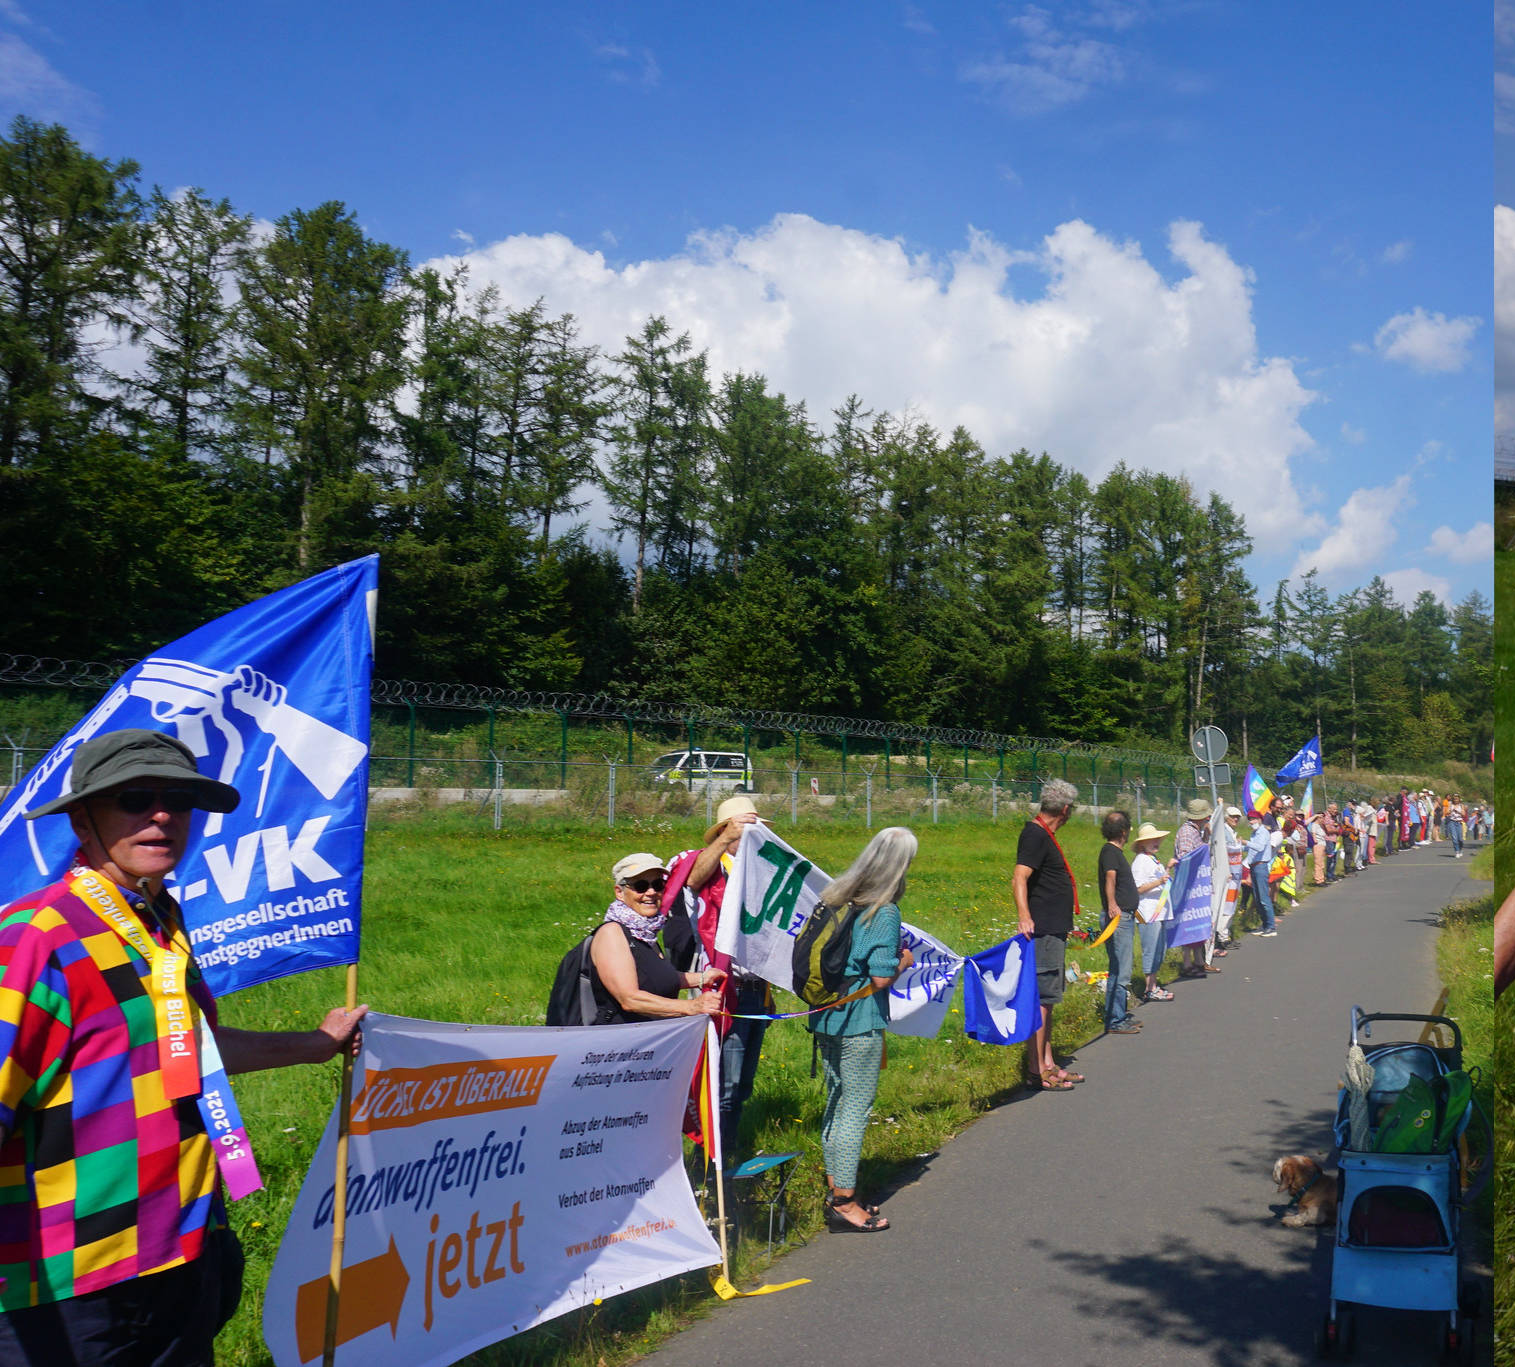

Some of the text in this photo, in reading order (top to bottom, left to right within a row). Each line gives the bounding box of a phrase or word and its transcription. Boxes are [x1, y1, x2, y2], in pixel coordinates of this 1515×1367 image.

[740, 839, 813, 935] JA
[165, 998, 192, 1060] Büchel
[604, 1050, 618, 1062] der
[418, 1076, 458, 1111] IST
[455, 1066, 545, 1107] ÜBERALL!
[571, 1067, 673, 1088] Aufrüstung in Deutschland
[203, 1089, 246, 1161] 5.9.2021
[561, 1111, 648, 1136] Abzug der Atomwaffen
[560, 1137, 603, 1160] aus Büchel
[558, 1176, 656, 1208] Verbot der Atomwaffen
[424, 1200, 526, 1333] jetzt
